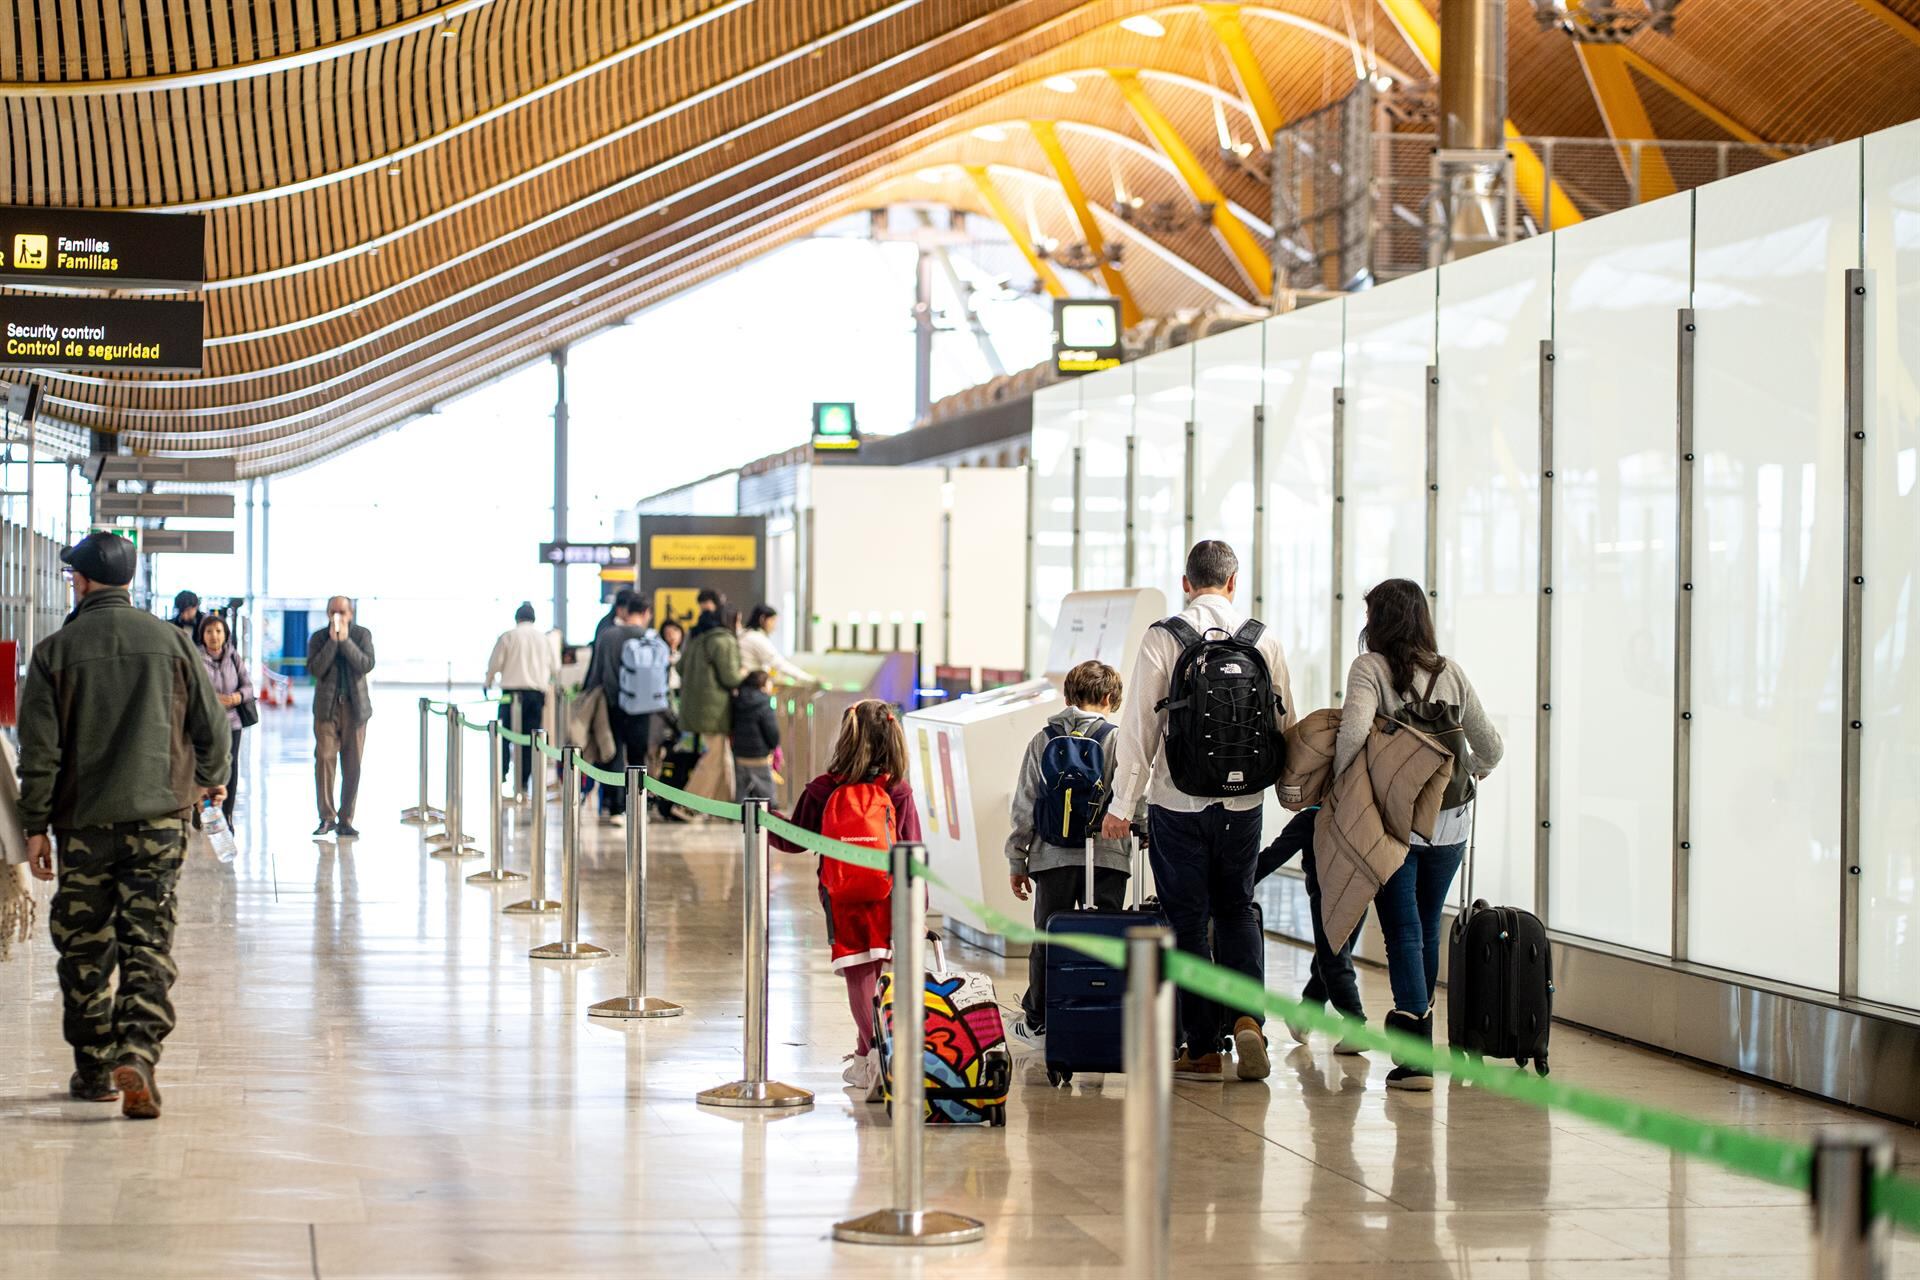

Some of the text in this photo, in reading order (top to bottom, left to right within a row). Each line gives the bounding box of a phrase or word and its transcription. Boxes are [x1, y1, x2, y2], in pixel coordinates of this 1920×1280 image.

[58, 236, 110, 253] Families
[57, 253, 119, 270] Familias
[7, 322, 105, 341] Security control
[7, 338, 160, 361] Control de seguridad
